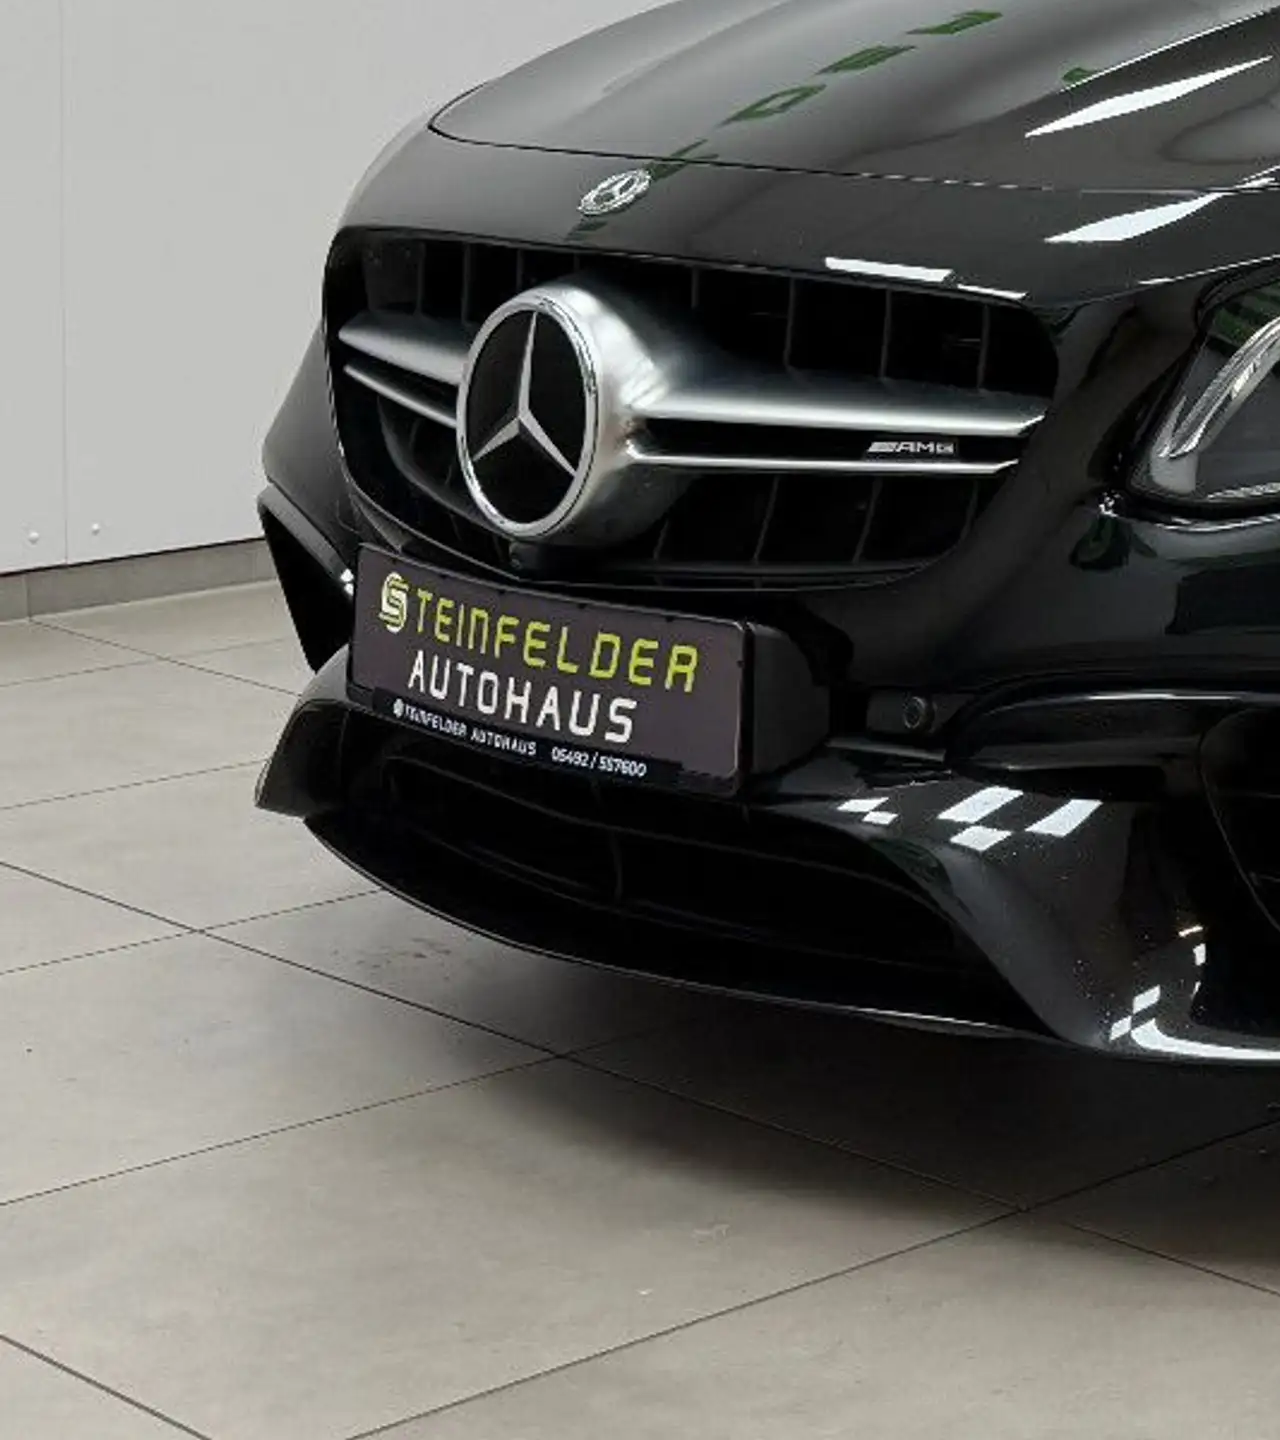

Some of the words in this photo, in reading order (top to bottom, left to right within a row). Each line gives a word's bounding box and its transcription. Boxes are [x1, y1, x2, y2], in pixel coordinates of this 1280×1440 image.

[894, 441, 954, 454] AMG
[379, 572, 698, 692] STEINFELDER
[408, 649, 638, 743] AUTOHAUS
[470, 727, 537, 756] AUTOHAUS
